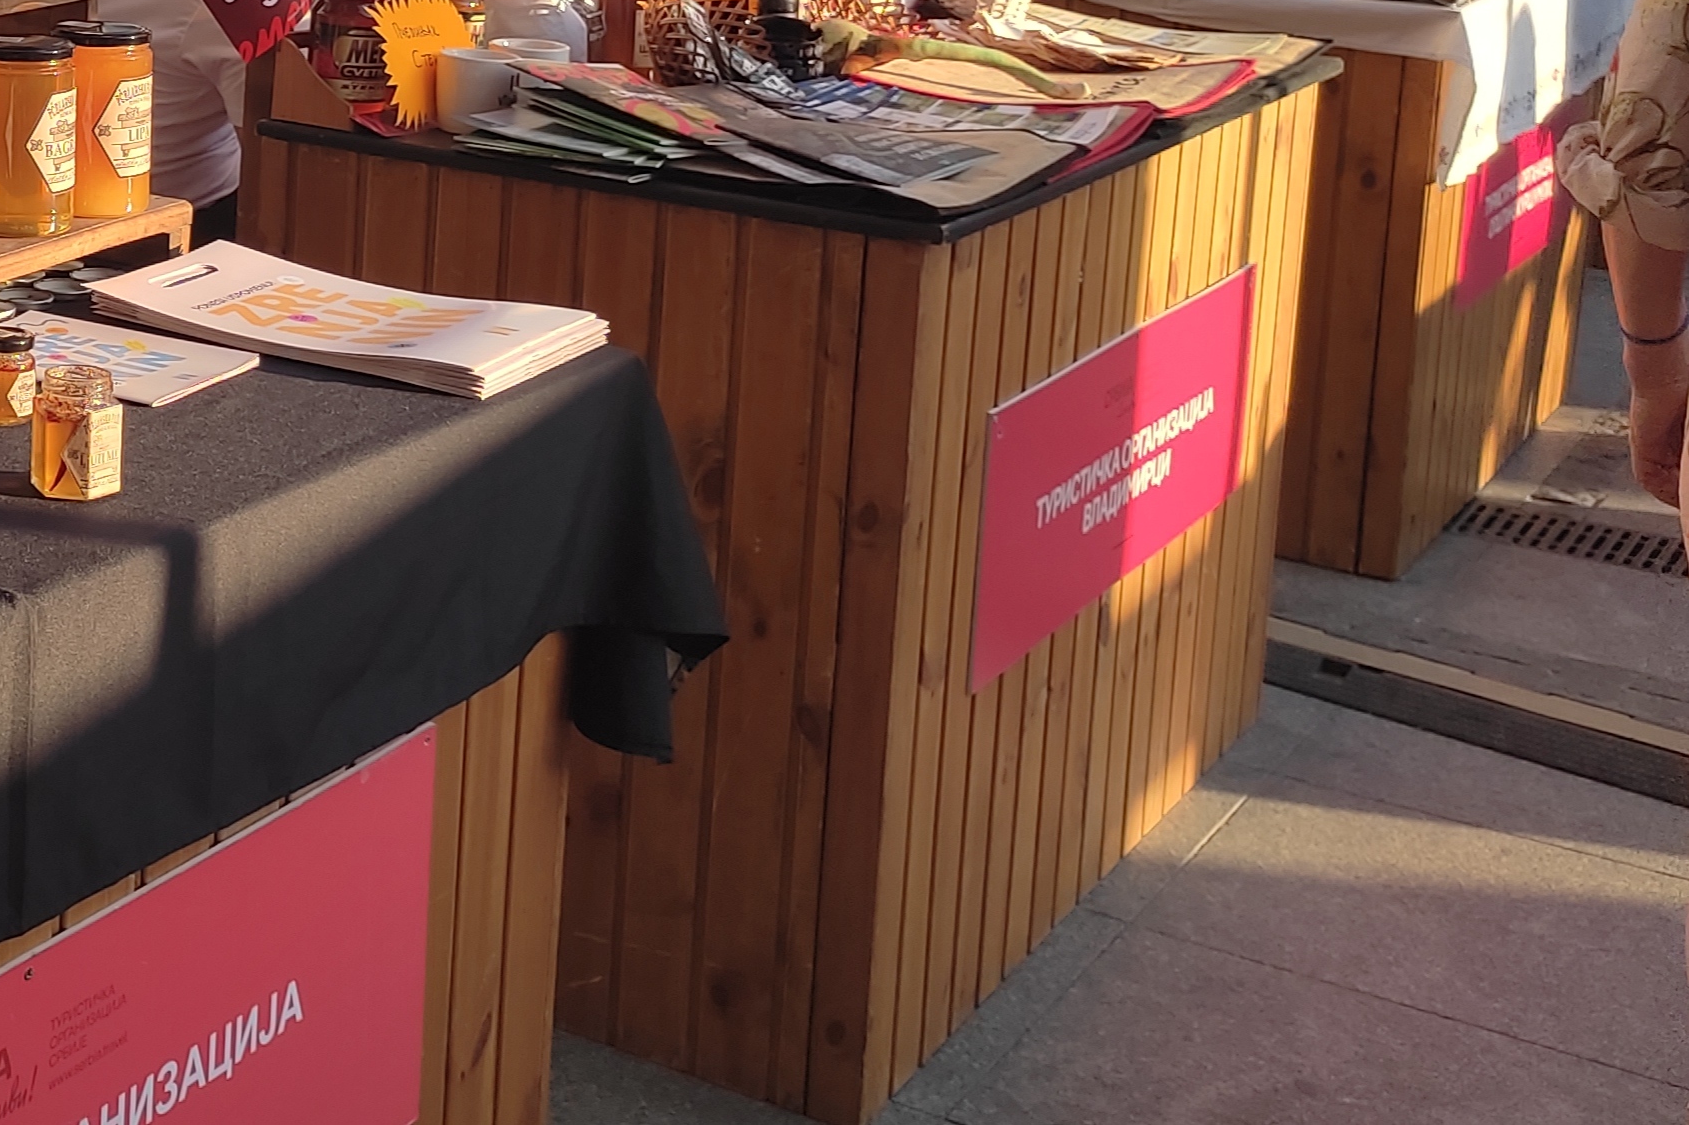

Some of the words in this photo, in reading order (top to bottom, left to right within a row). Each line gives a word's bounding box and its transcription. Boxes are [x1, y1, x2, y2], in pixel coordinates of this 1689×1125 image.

[207, 283, 350, 328] ZRE
[1036, 446, 1121, 530] ТУРИСТИЧКА
[1121, 386, 1215, 470] ОРГАНИЗАЦИЈА
[1082, 447, 1172, 535] ВЛАДИМИРЦИ
[49, 984, 116, 1031] ТУРИСТИЧКА
[49, 993, 128, 1050] ОРГАНИЗАЦИЈА
[48, 1034, 88, 1068] СРБИЈЕ
[77, 979, 304, 1125] НИЗАЦИЈА
